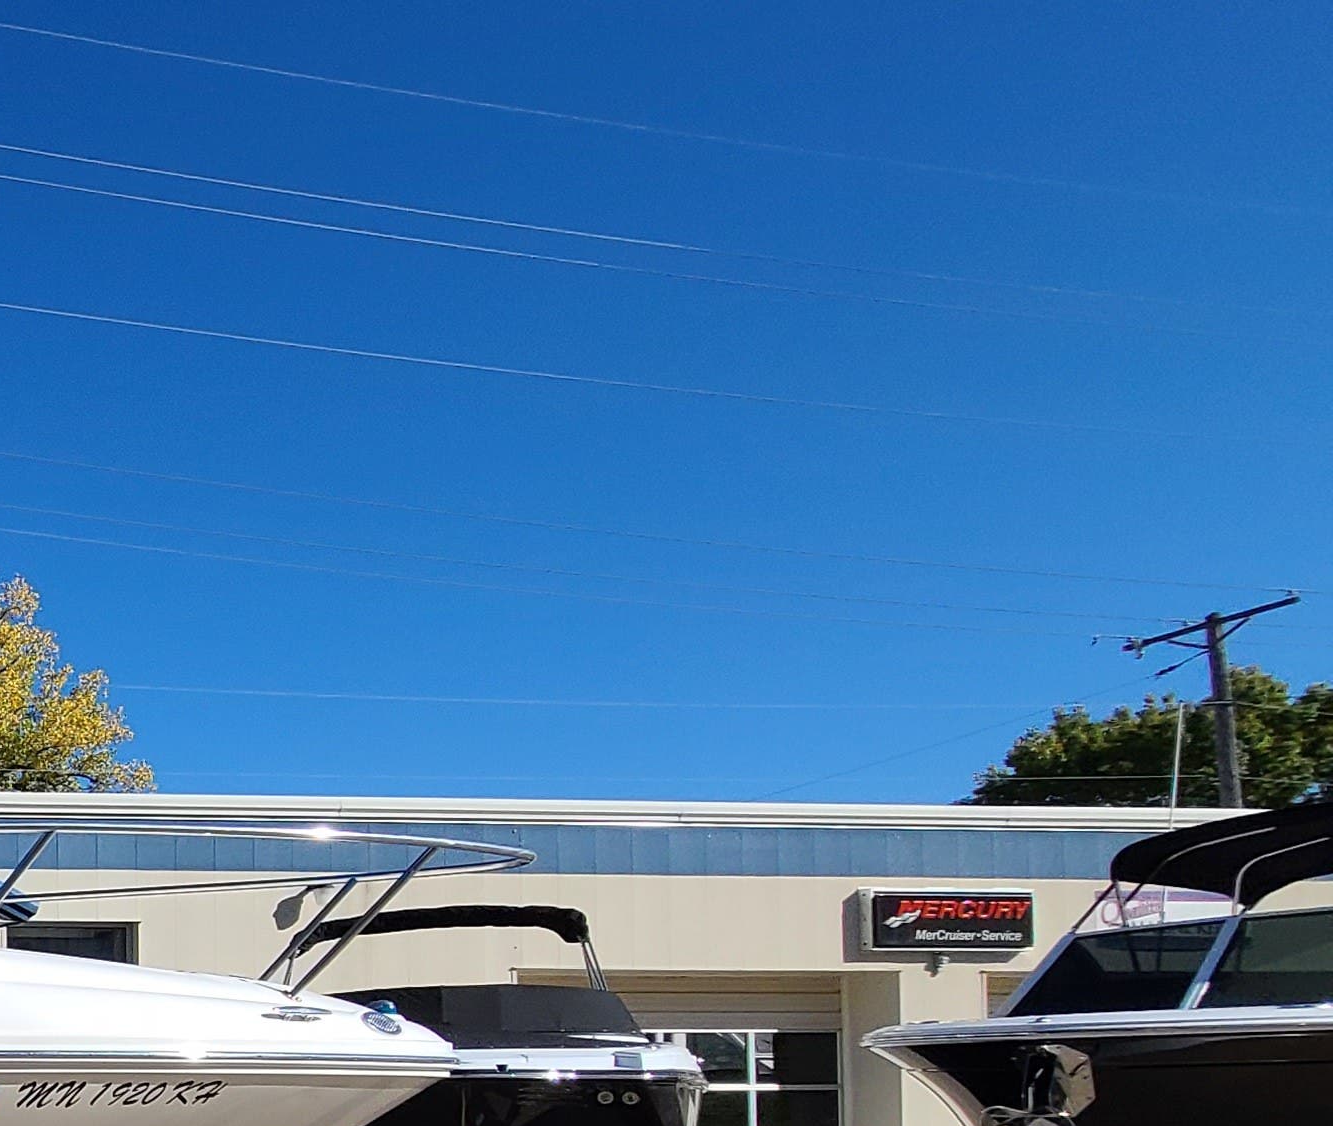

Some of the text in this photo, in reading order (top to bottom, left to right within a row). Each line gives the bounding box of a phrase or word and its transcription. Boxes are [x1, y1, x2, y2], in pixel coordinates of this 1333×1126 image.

[898, 900, 1030, 920] MERCURY
[16, 1080, 229, 1108] MN 1920 KH
